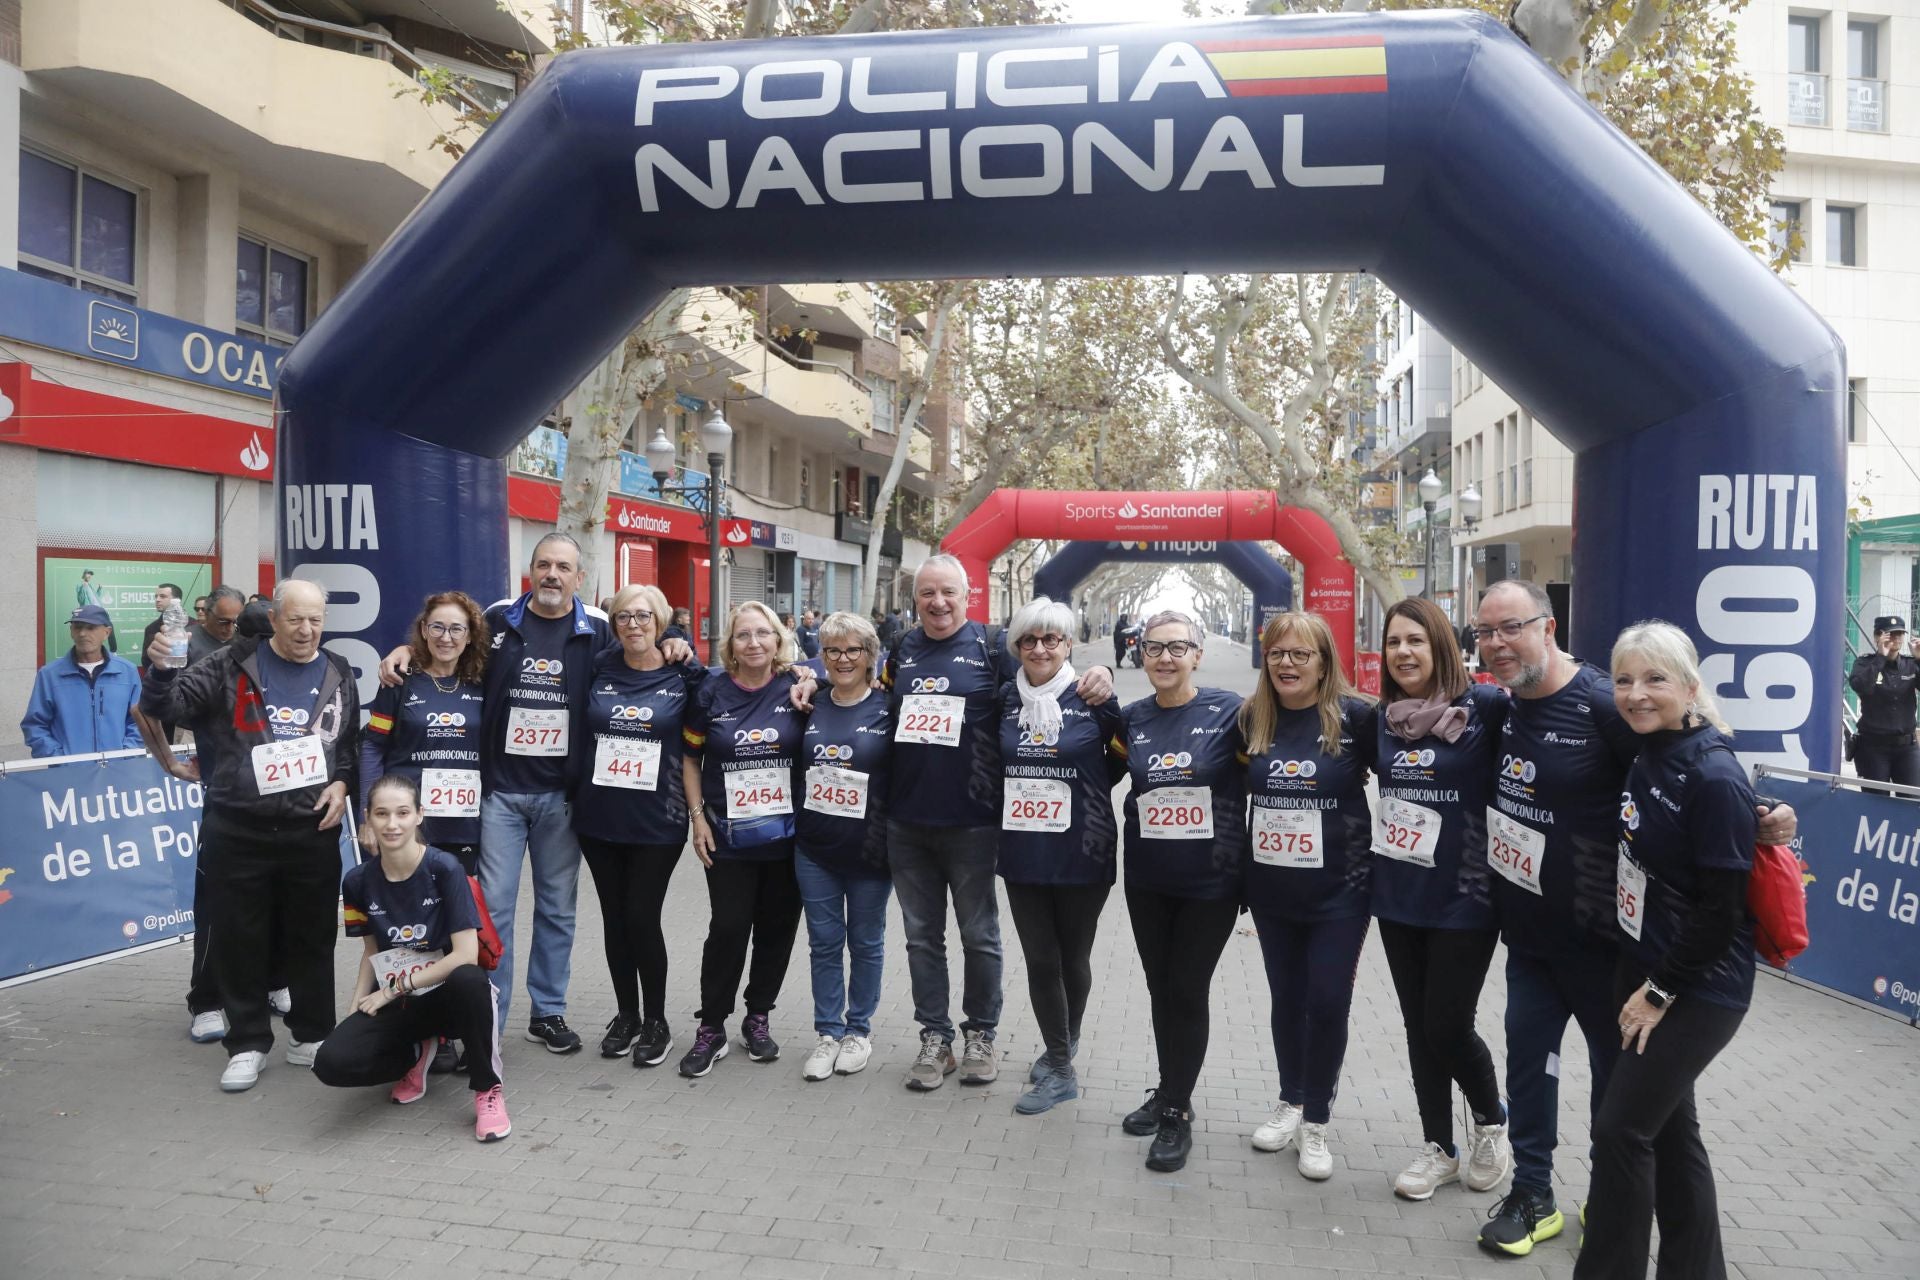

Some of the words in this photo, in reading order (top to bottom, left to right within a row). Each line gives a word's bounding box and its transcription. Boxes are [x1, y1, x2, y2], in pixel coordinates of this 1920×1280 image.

[635, 114, 1385, 212] NACIONAL
[182, 331, 284, 390] OCA
[286, 484, 379, 551] RUTA
[630, 510, 672, 534] Santander
[1065, 503, 1116, 522] Sports
[1140, 503, 1224, 519] Santander
[1698, 474, 1819, 551] RUTA
[1320, 577, 1345, 587] Sports
[904, 714, 952, 733] 2221
[513, 727, 562, 745] 2377
[265, 755, 318, 782] 2117
[607, 759, 643, 778] 441
[430, 788, 476, 806] 2150
[735, 787, 784, 807] 2454
[812, 783, 859, 806] 2453
[1011, 799, 1063, 819] 2627
[1147, 806, 1204, 826] 2280
[1258, 831, 1313, 853] 2375
[1386, 823, 1423, 851] 327
[43, 842, 92, 882] de
[102, 834, 142, 871] la
[1493, 836, 1532, 878] 2374
[1836, 868, 1879, 912] de
[1888, 878, 1919, 925] la
